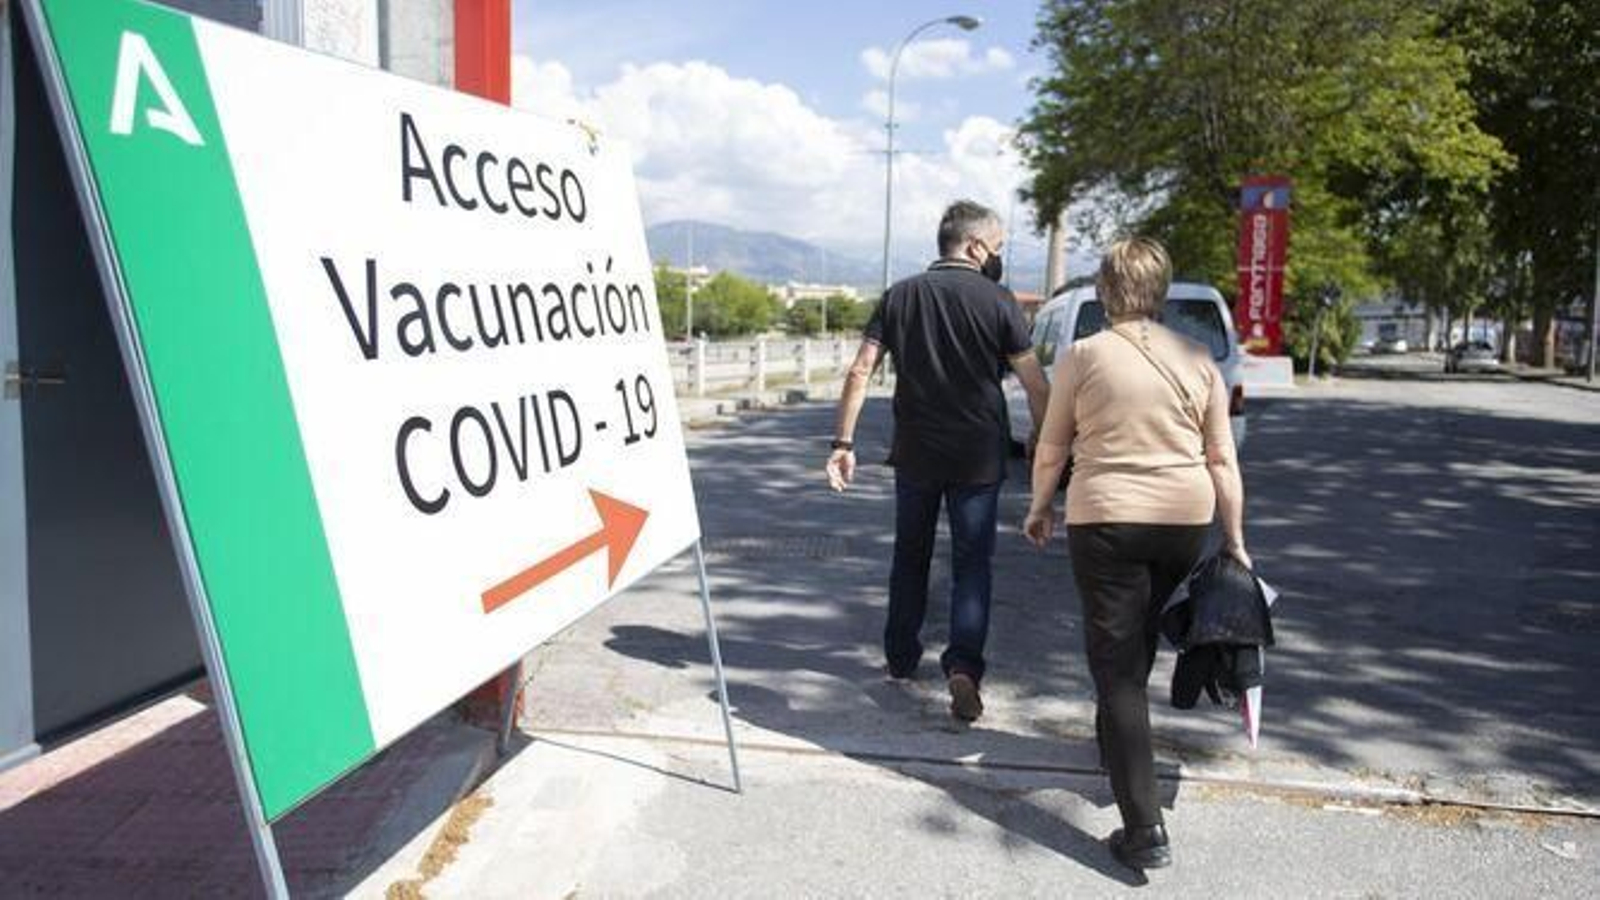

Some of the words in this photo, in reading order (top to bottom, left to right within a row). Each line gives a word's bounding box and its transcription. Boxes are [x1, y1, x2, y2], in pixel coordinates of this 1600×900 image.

[401, 113, 586, 223] Acceso
[321, 257, 650, 360] Vacunación
[396, 390, 582, 515] COVID
[615, 374, 658, 445] 19
